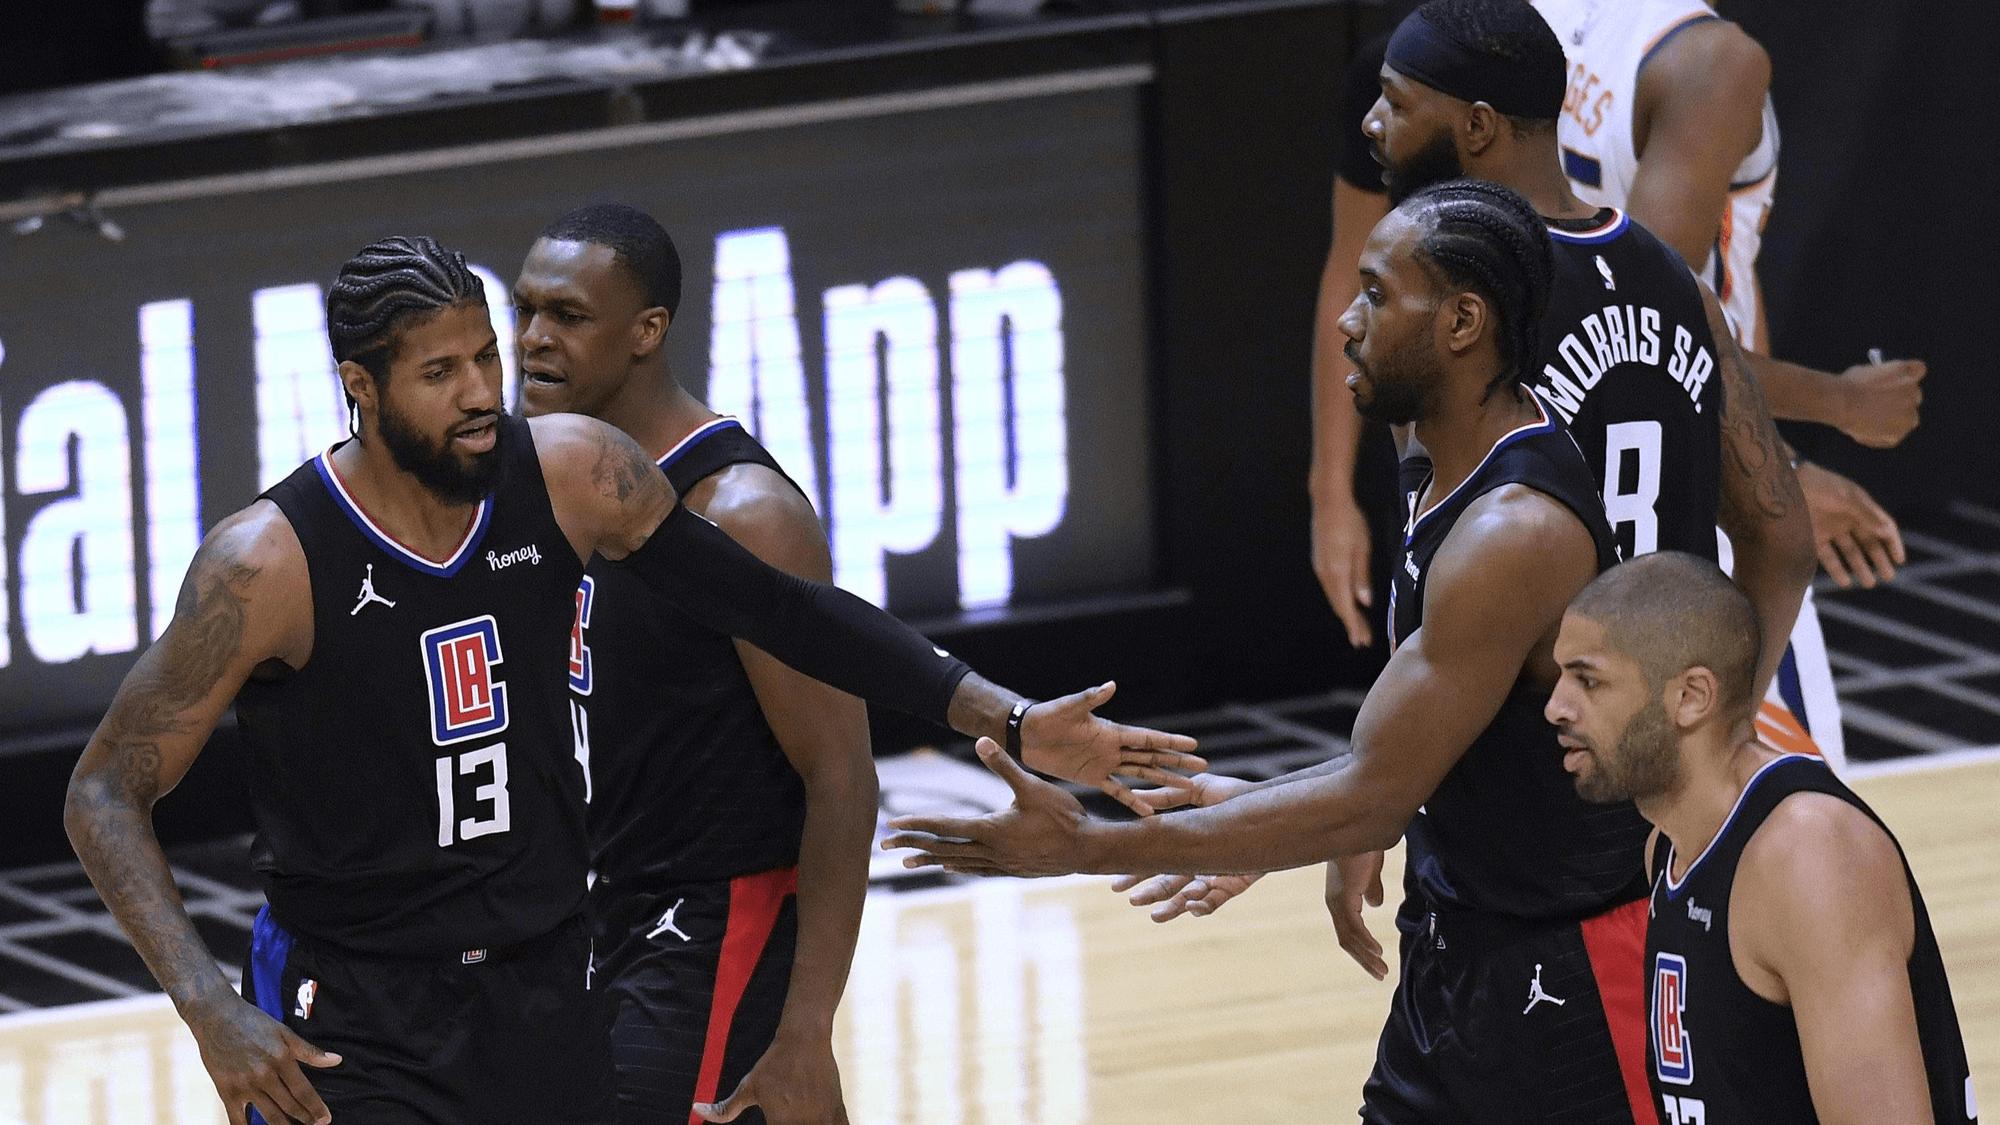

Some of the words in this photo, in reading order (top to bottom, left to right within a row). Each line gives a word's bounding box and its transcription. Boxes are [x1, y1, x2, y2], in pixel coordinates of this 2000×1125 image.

[1562, 60, 1613, 137] GES
[1534, 304, 1661, 426] MORRIS
[1667, 324, 1714, 415] SR.
[0, 299, 205, 669] al
[707, 226, 1069, 612] App
[1603, 420, 1662, 558] 8
[485, 543, 542, 571] honey
[436, 742, 511, 848] 13
